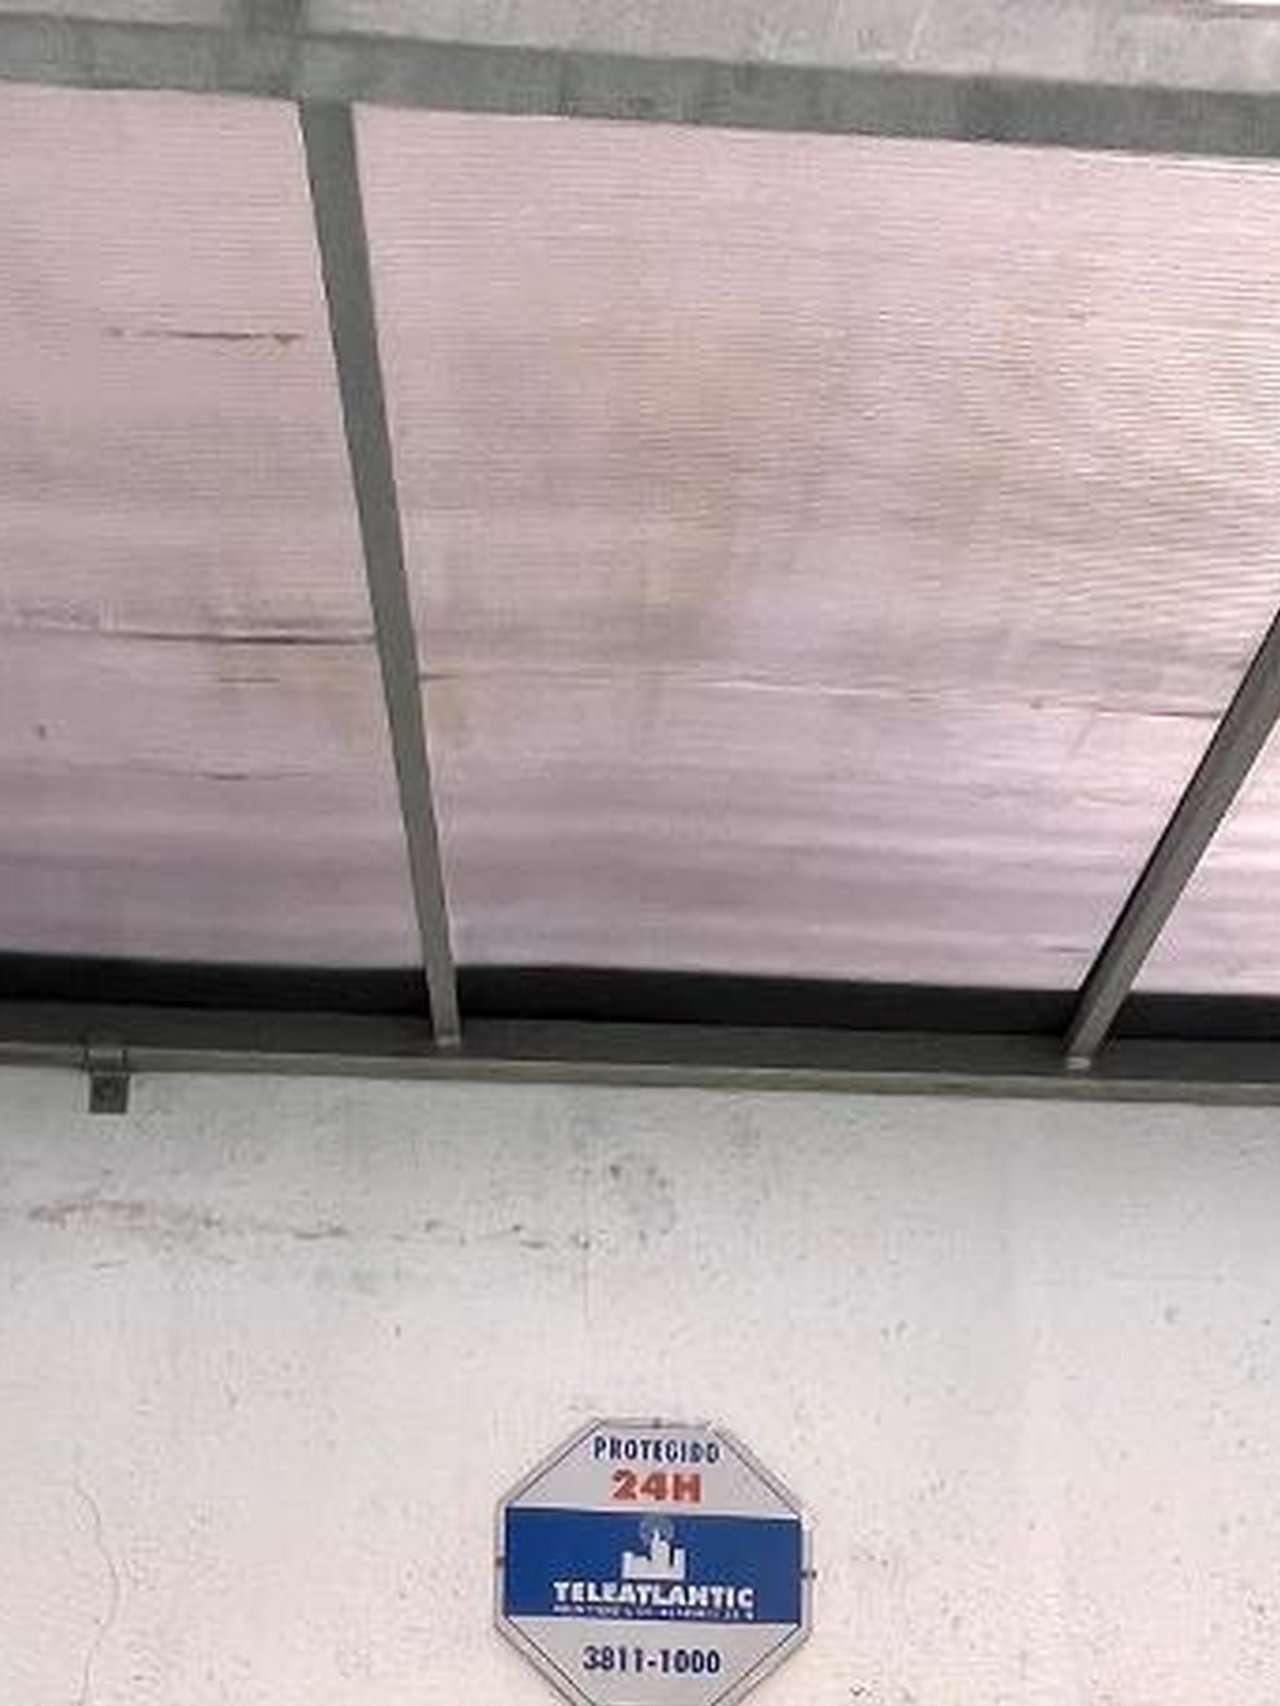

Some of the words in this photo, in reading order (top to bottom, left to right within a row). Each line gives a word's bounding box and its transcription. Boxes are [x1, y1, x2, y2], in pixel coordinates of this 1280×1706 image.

[593, 1435, 720, 1463] PROTEGIDO
[612, 1468, 702, 1503] 24H
[552, 1580, 754, 1609] TELEATLANTIC
[583, 1645, 721, 1674] 3811-1000
